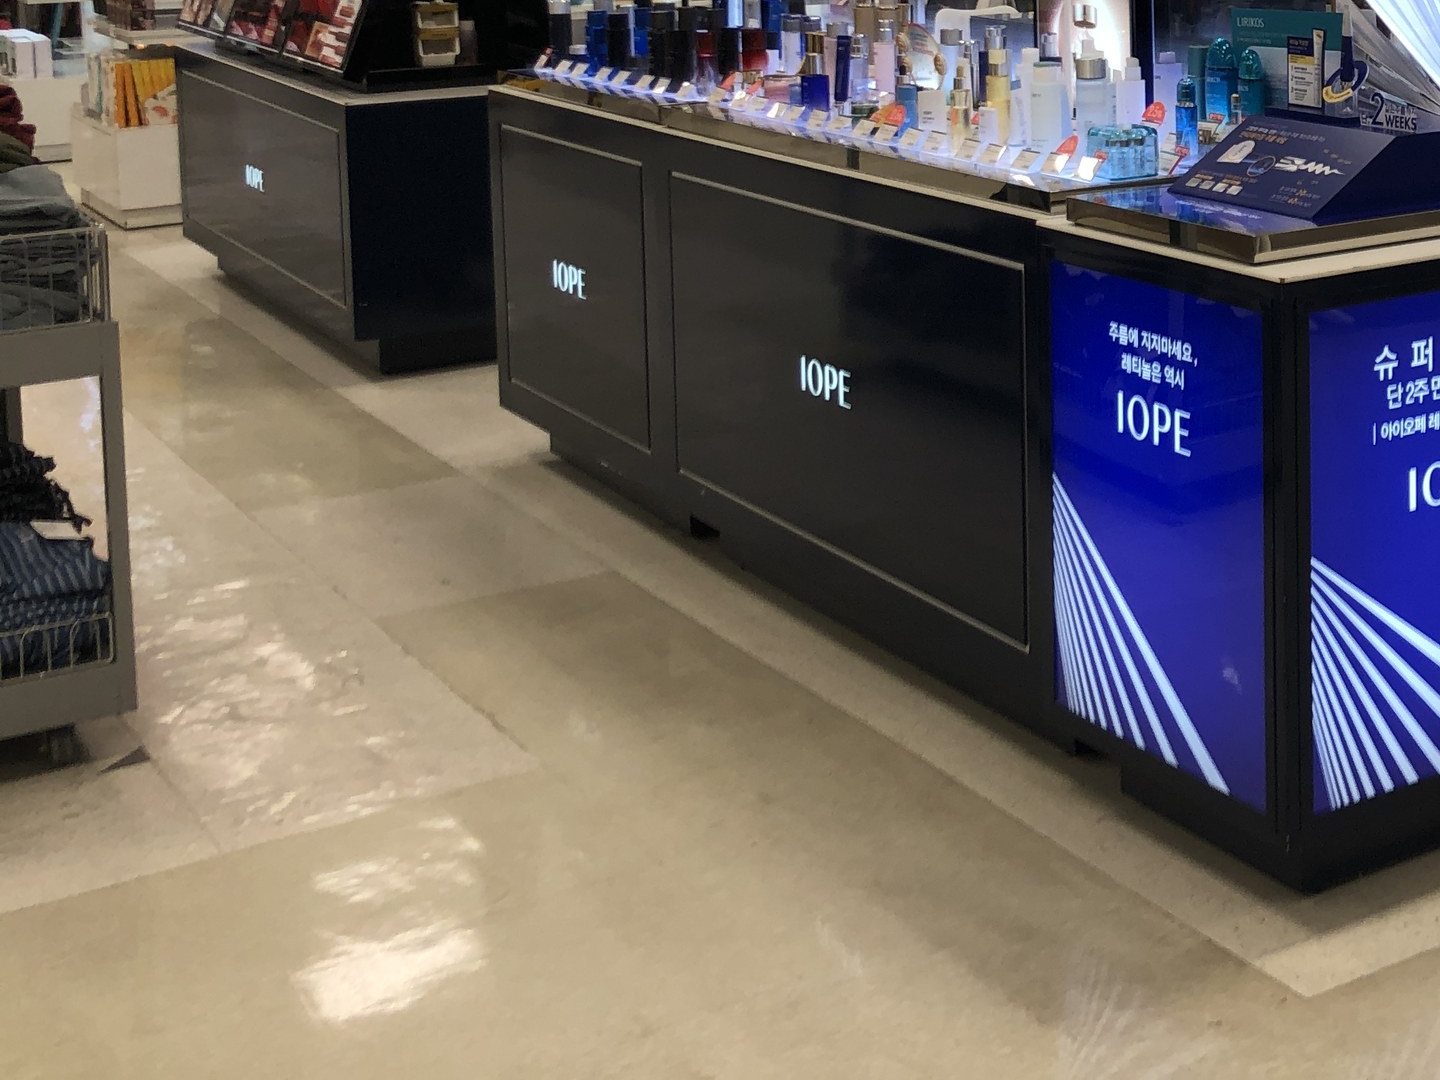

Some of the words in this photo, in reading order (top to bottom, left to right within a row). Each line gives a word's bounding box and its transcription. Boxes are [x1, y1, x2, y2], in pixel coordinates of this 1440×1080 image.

[1371, 92, 1384, 126] 2
[1385, 114, 1417, 131] WEEKS
[245, 163, 265, 193] IOPE
[552, 258, 588, 301] IOPE
[1108, 320, 1139, 349] 주름에
[1141, 330, 1198, 368] 지지마세요,
[799, 354, 852, 410] IOPE
[1121, 352, 1162, 384] 레티놀은
[1164, 364, 1185, 391] 역시
[1387, 381, 1403, 410] 단
[1405, 377, 1430, 405] 2주
[1115, 389, 1192, 458] IOPE
[1380, 412, 1427, 442] 아이오페
